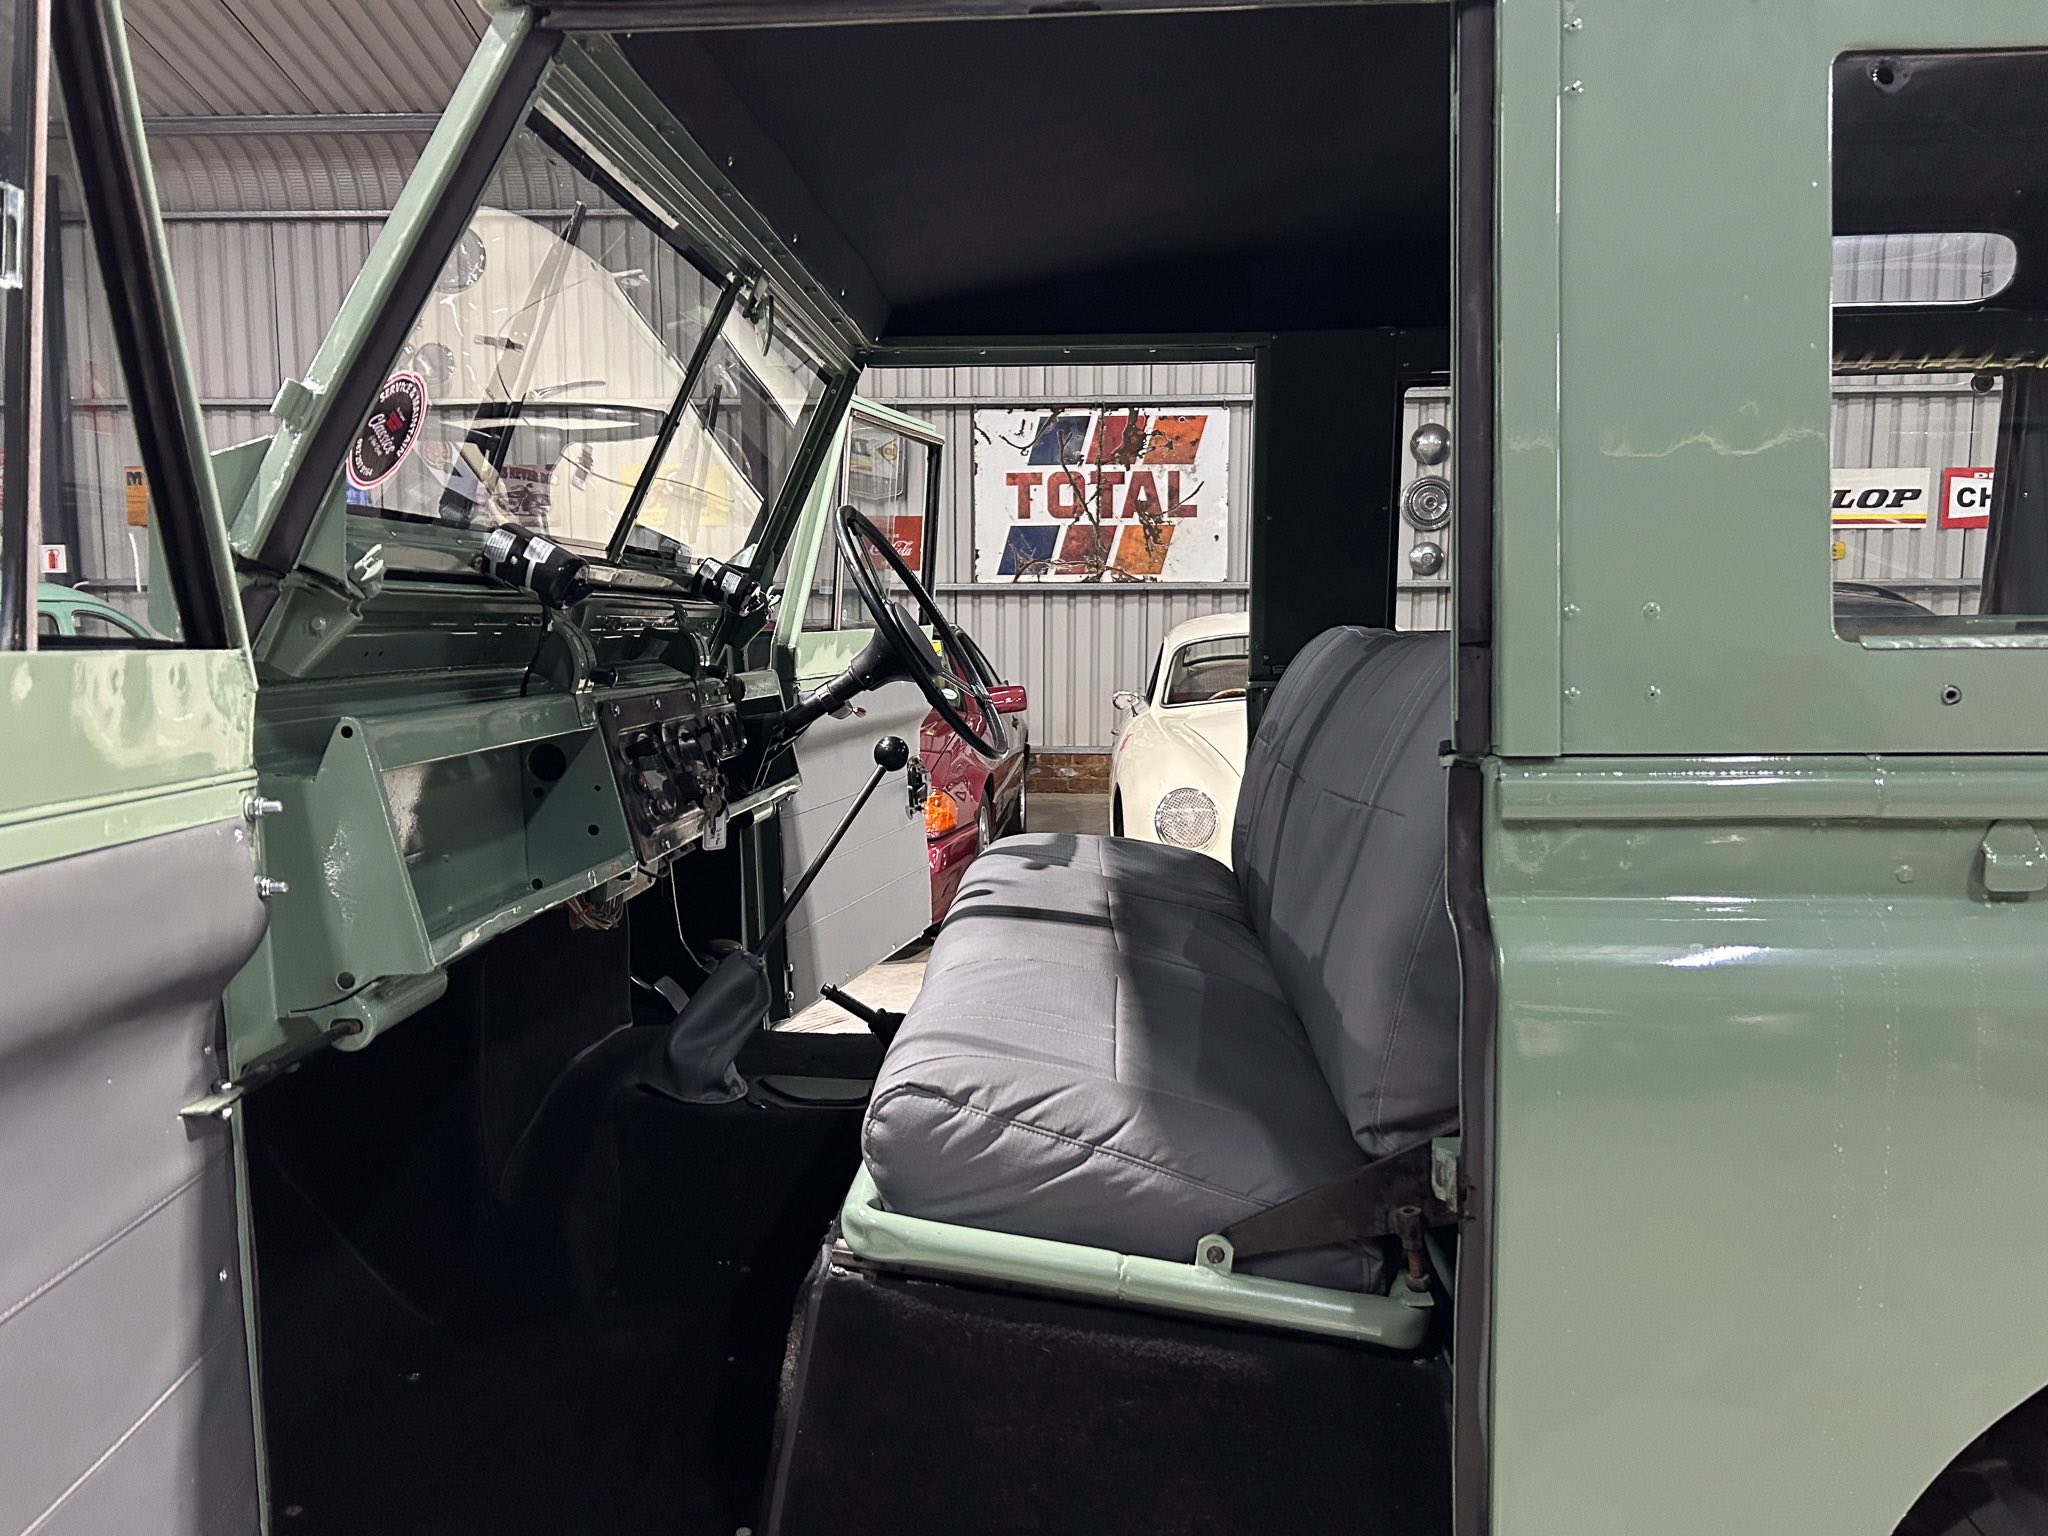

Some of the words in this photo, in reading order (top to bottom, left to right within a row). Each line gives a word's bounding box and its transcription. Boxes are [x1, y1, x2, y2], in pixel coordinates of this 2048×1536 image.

[368, 413, 396, 455] Classics
[379, 382, 411, 403] SERVICE
[396, 394, 421, 457] MAINTAIN
[1005, 470, 1198, 519] TOTAL
[1832, 488, 1922, 509] LOP
[1956, 486, 1991, 507] CH
